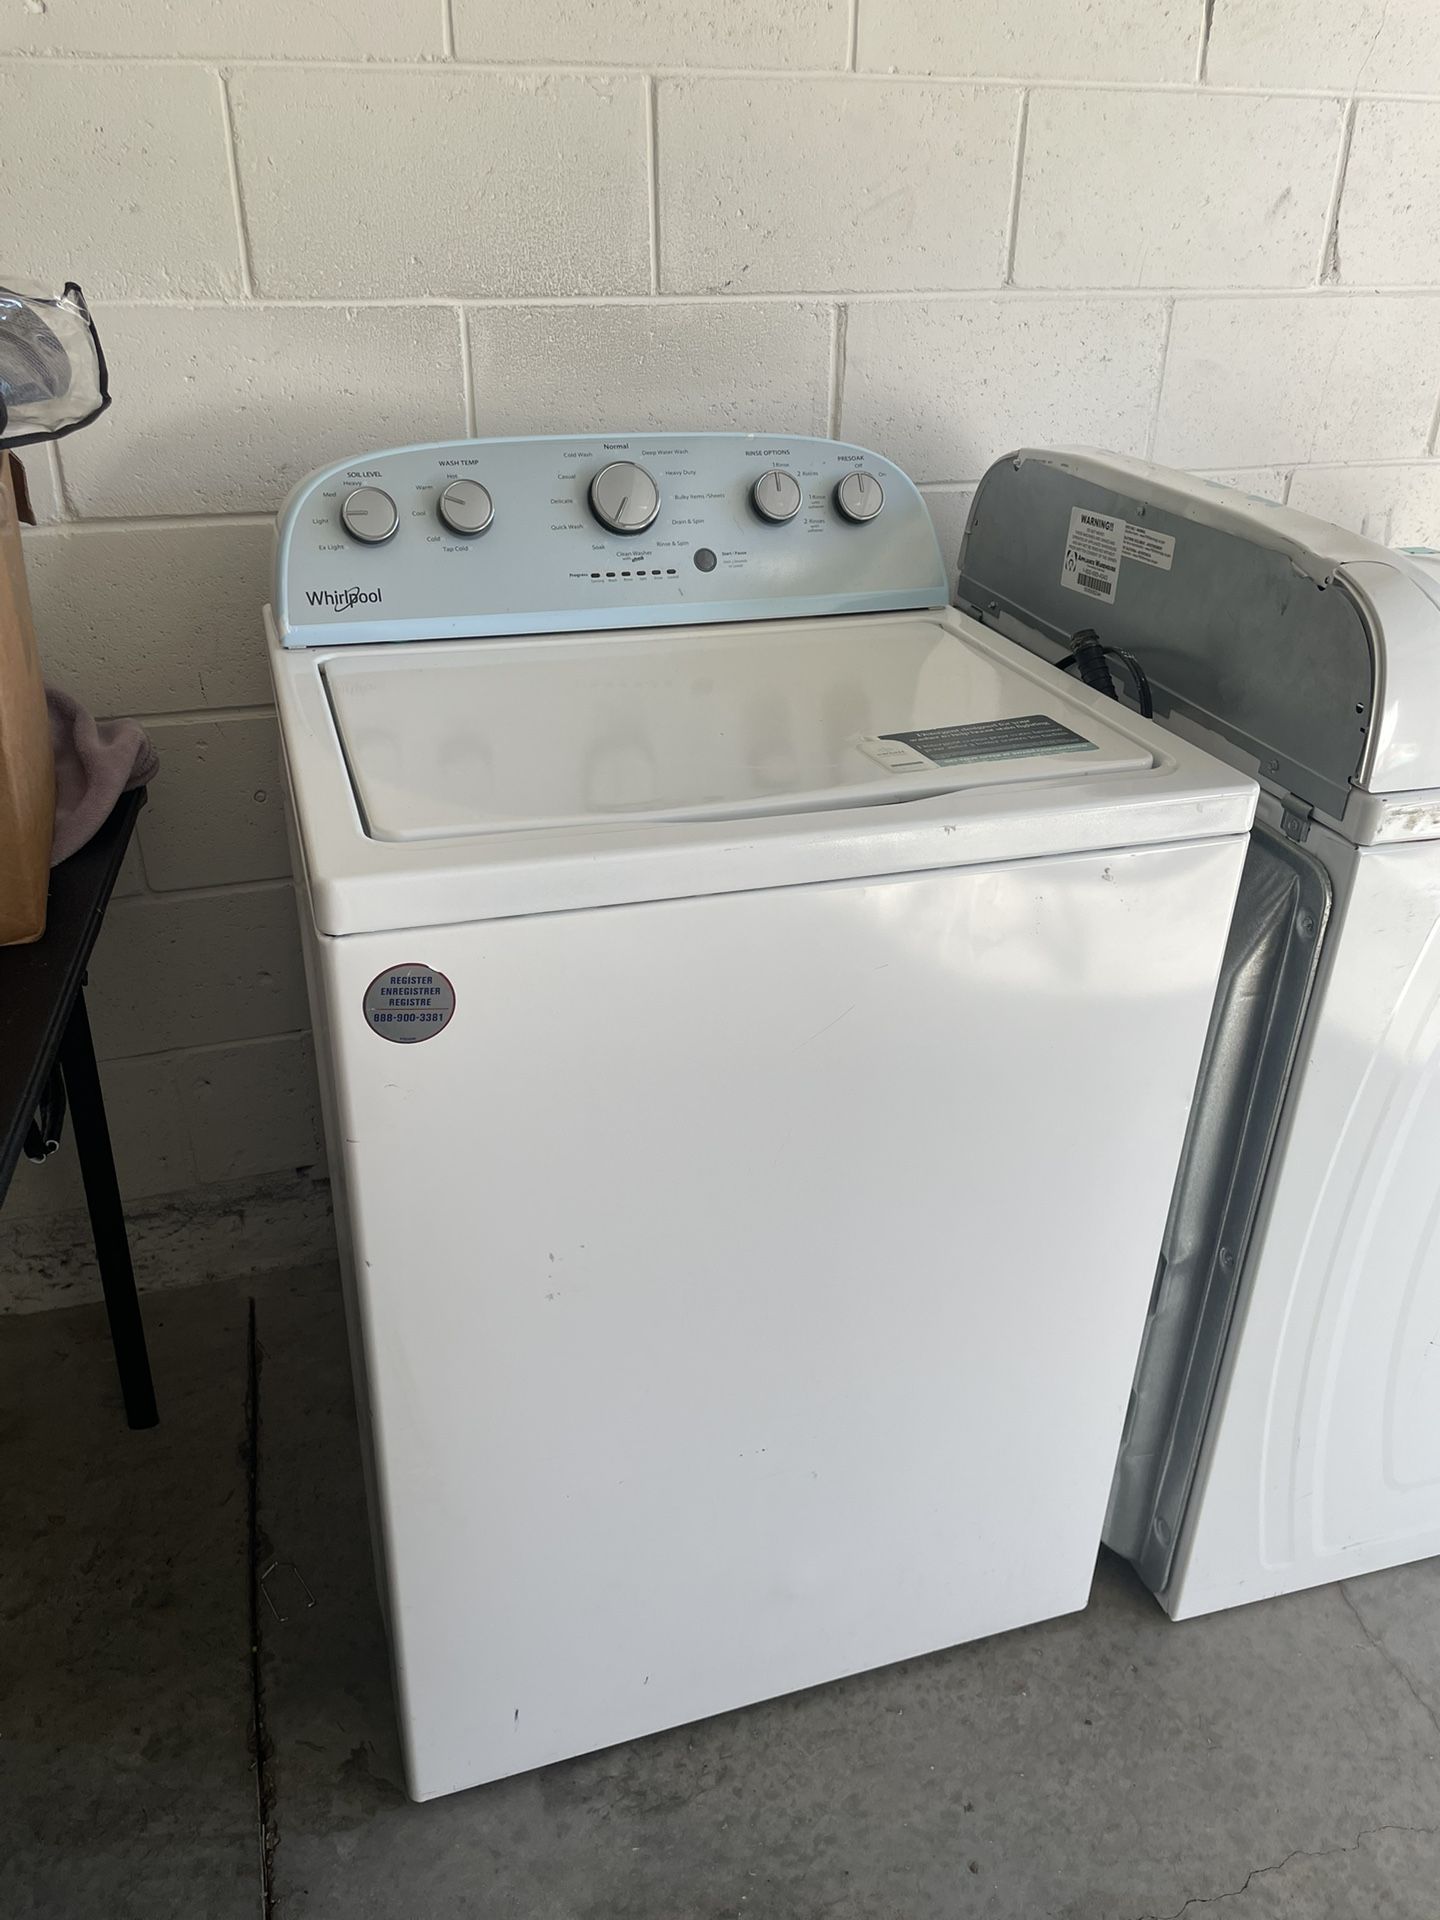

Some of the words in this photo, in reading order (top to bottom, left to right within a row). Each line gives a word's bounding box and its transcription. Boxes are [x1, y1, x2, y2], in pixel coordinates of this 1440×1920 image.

[305, 586, 382, 612] Whirlpool
[390, 976, 433, 984] REGISTER
[381, 987, 440, 995] ENREGISTRER
[389, 998, 431, 1006] REGISTRE
[373, 1013, 443, 1022] 888-900-3381
